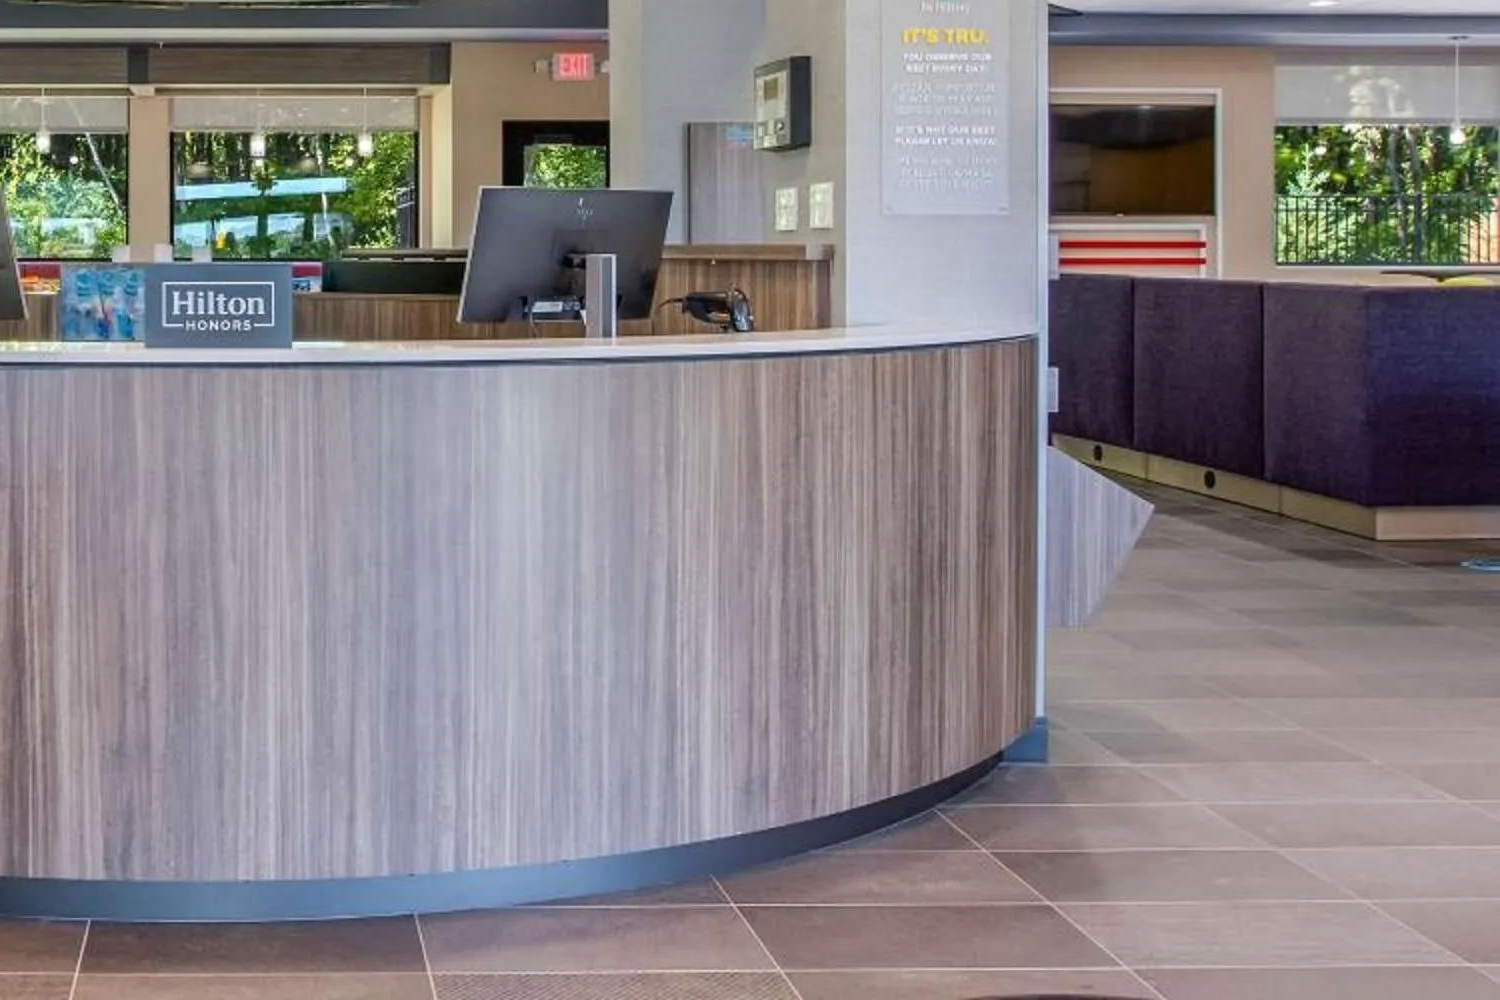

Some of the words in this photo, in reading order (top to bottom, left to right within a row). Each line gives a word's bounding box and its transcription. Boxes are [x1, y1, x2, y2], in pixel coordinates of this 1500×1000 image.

[902, 27, 938, 43] IT'S
[944, 27, 990, 43] TRU.
[559, 54, 588, 76] EXIT
[171, 290, 265, 316] Hilton
[185, 319, 252, 331] HONORS
